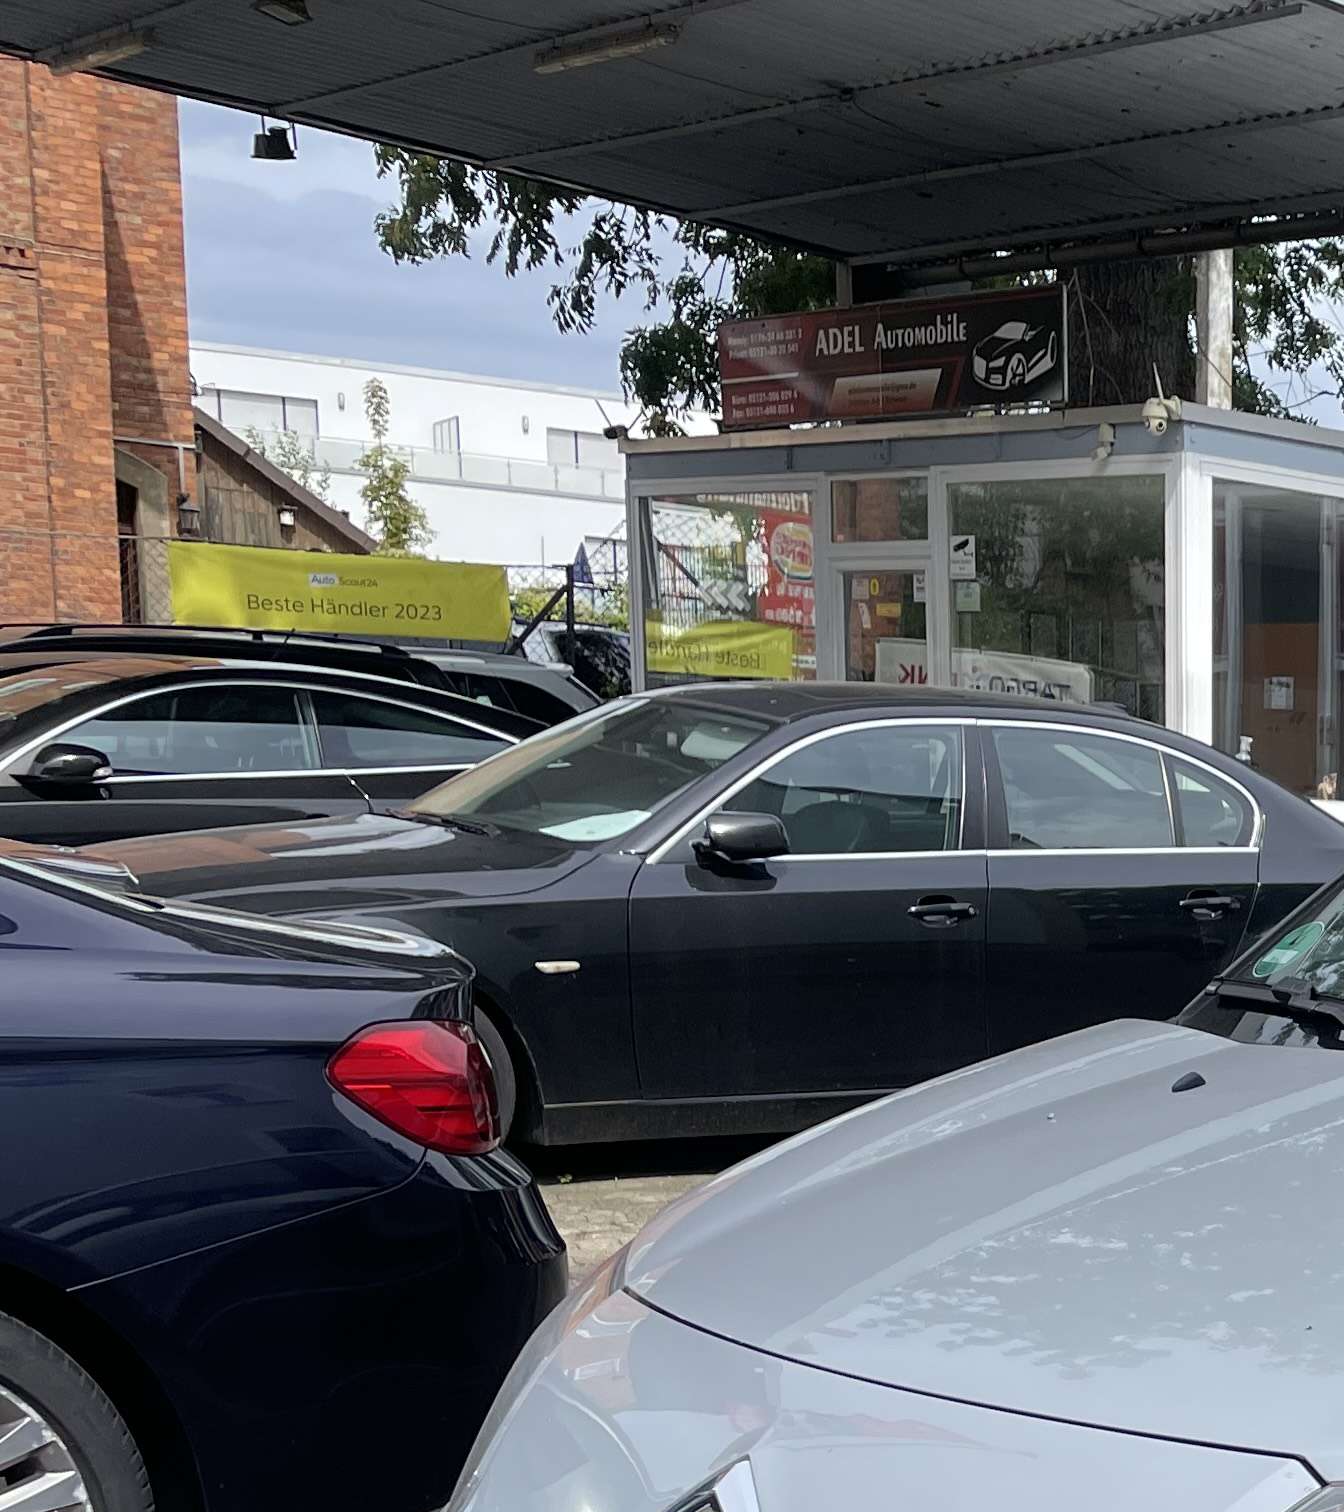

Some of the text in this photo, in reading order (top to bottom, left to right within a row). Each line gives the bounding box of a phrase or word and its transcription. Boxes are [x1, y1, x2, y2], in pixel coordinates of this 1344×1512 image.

[815, 325, 865, 357] ADEL
[247, 594, 442, 621] Beste Händler 2023
